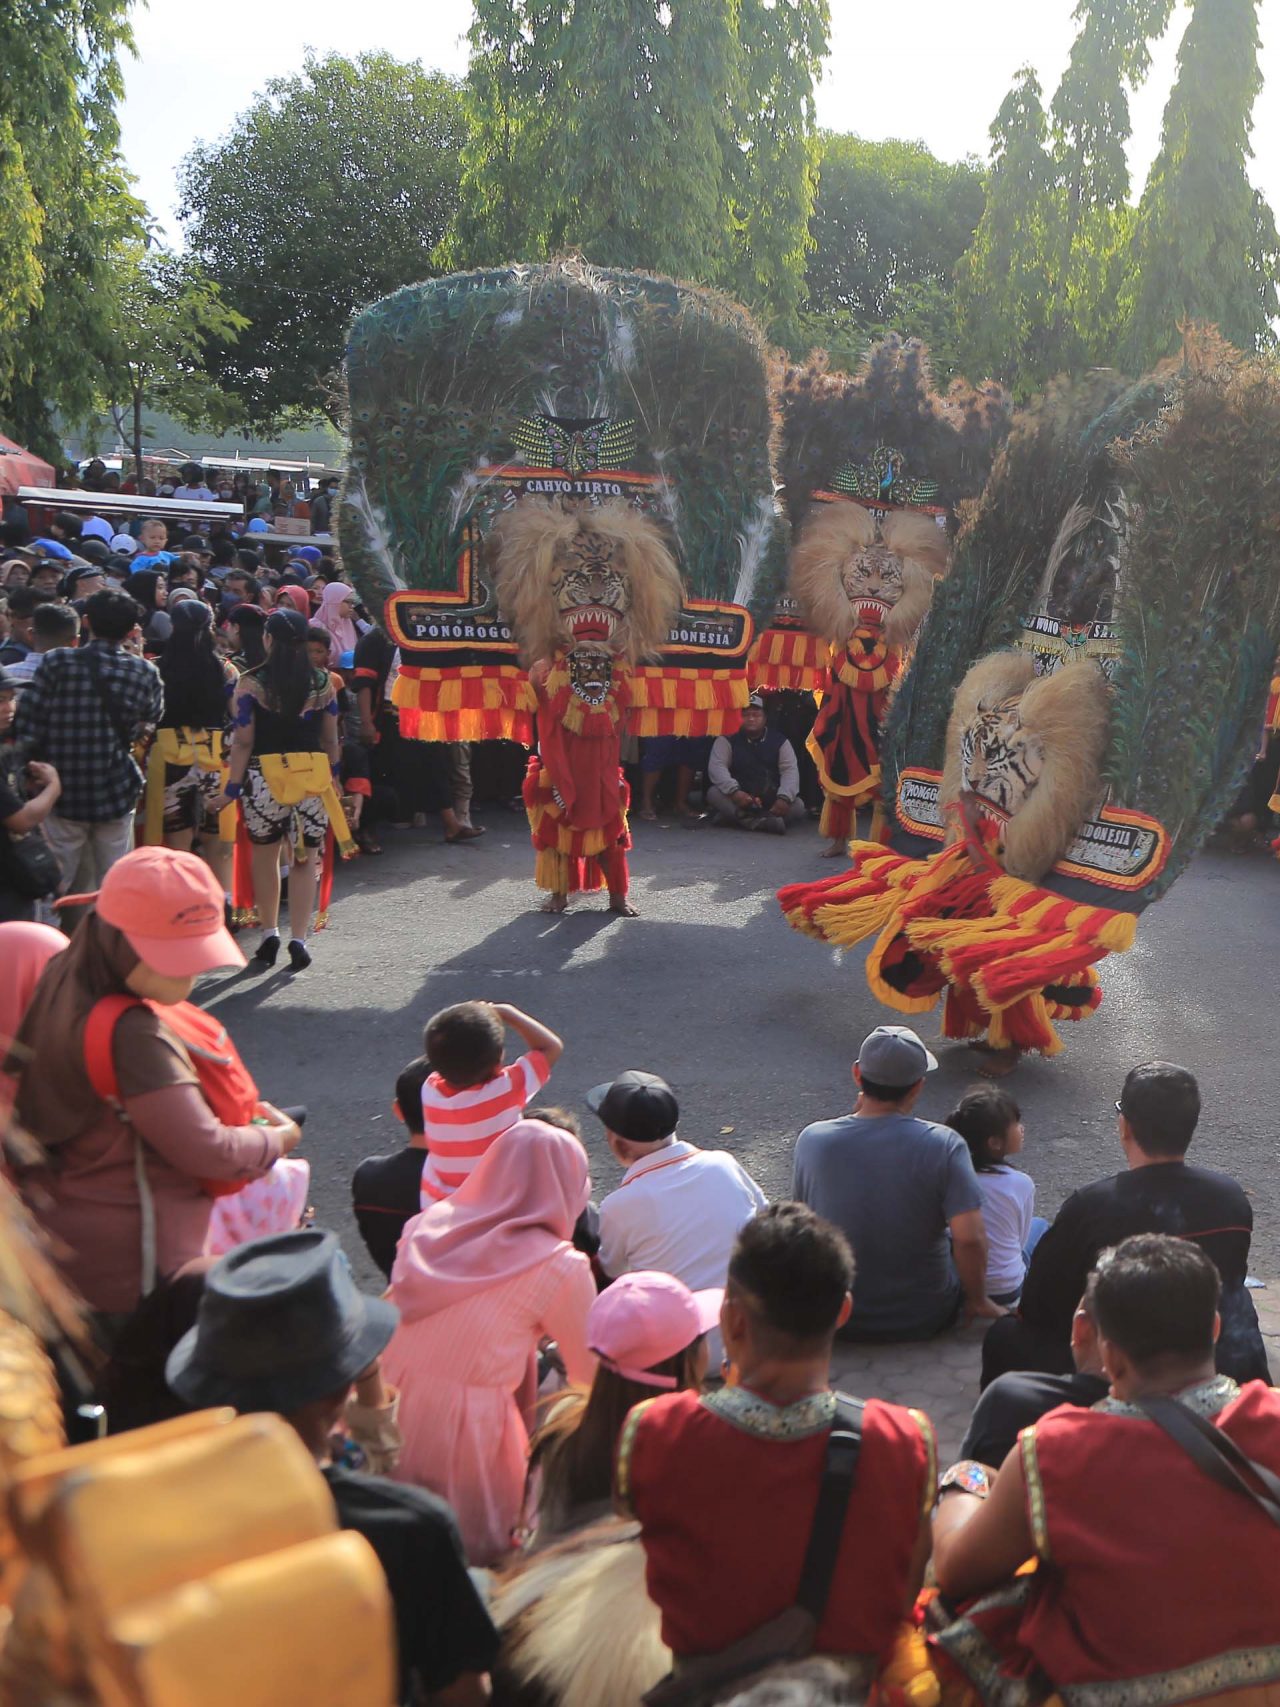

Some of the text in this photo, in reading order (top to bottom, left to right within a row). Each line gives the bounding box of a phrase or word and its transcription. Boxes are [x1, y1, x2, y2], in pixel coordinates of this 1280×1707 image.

[526, 480, 621, 495] CAHYO TIRTO
[416, 625, 512, 639] PONOROGO
